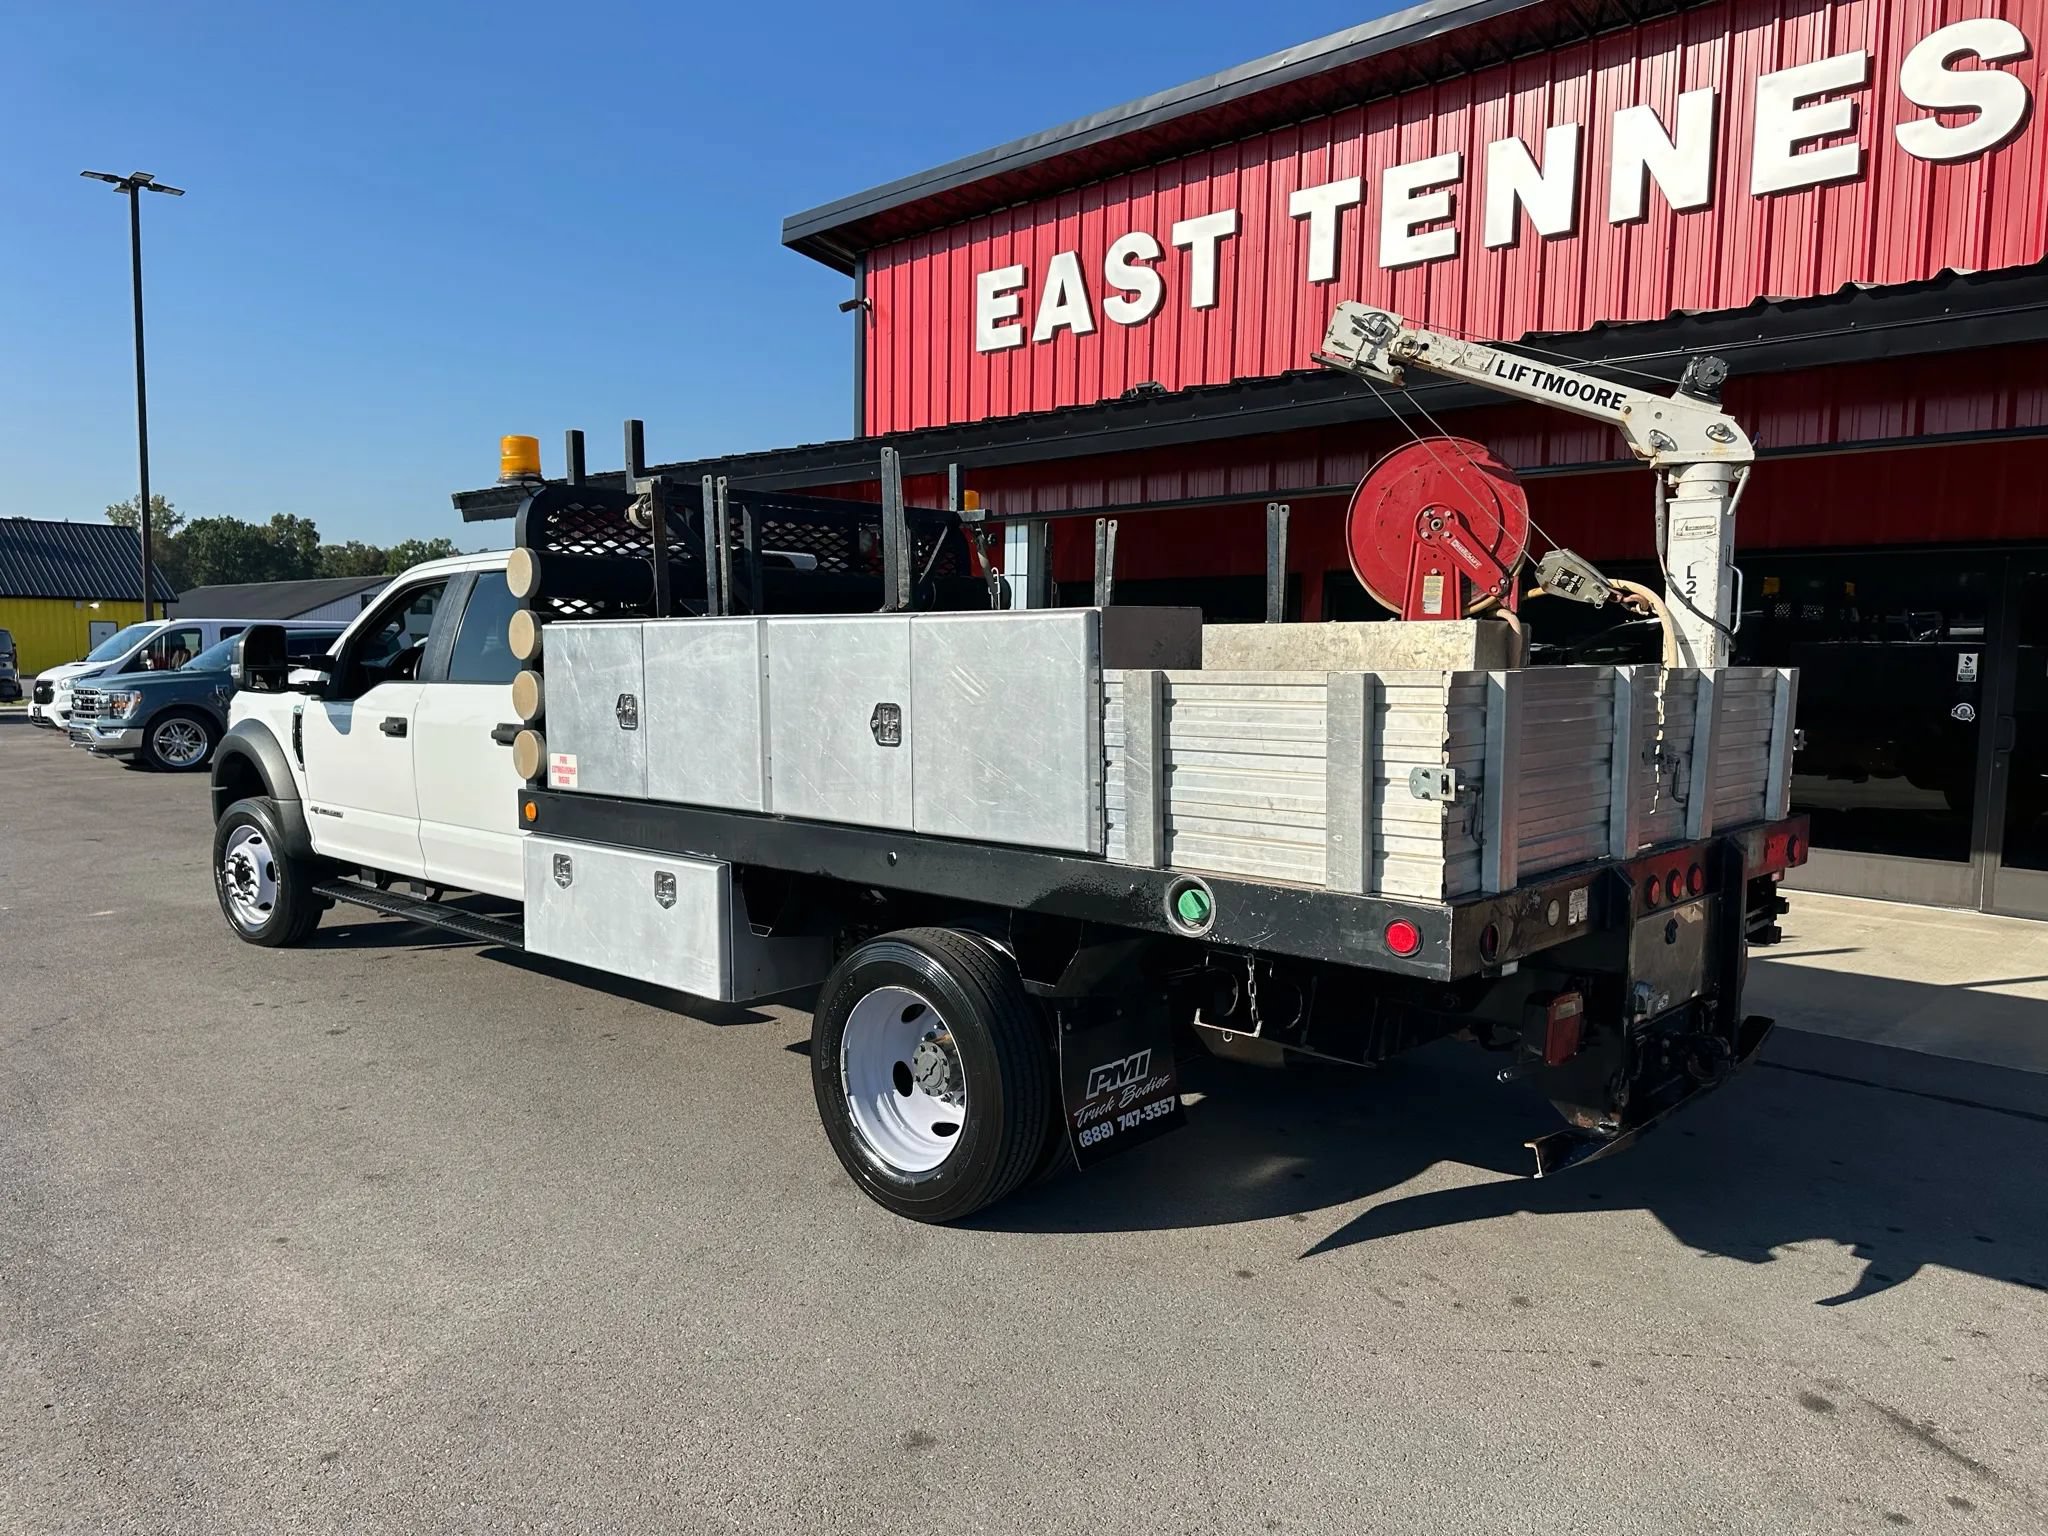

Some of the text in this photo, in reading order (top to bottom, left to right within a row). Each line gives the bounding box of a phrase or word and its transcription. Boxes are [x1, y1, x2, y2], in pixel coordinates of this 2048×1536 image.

[976, 17, 2030, 353] EAST TENNES
[1494, 359, 1627, 411] LIFTMOORE
[1086, 1048, 1152, 1100] PMI
[1074, 1073, 1172, 1129] Truck Bodies
[1079, 1096, 1176, 1148] (888) 747-3357
